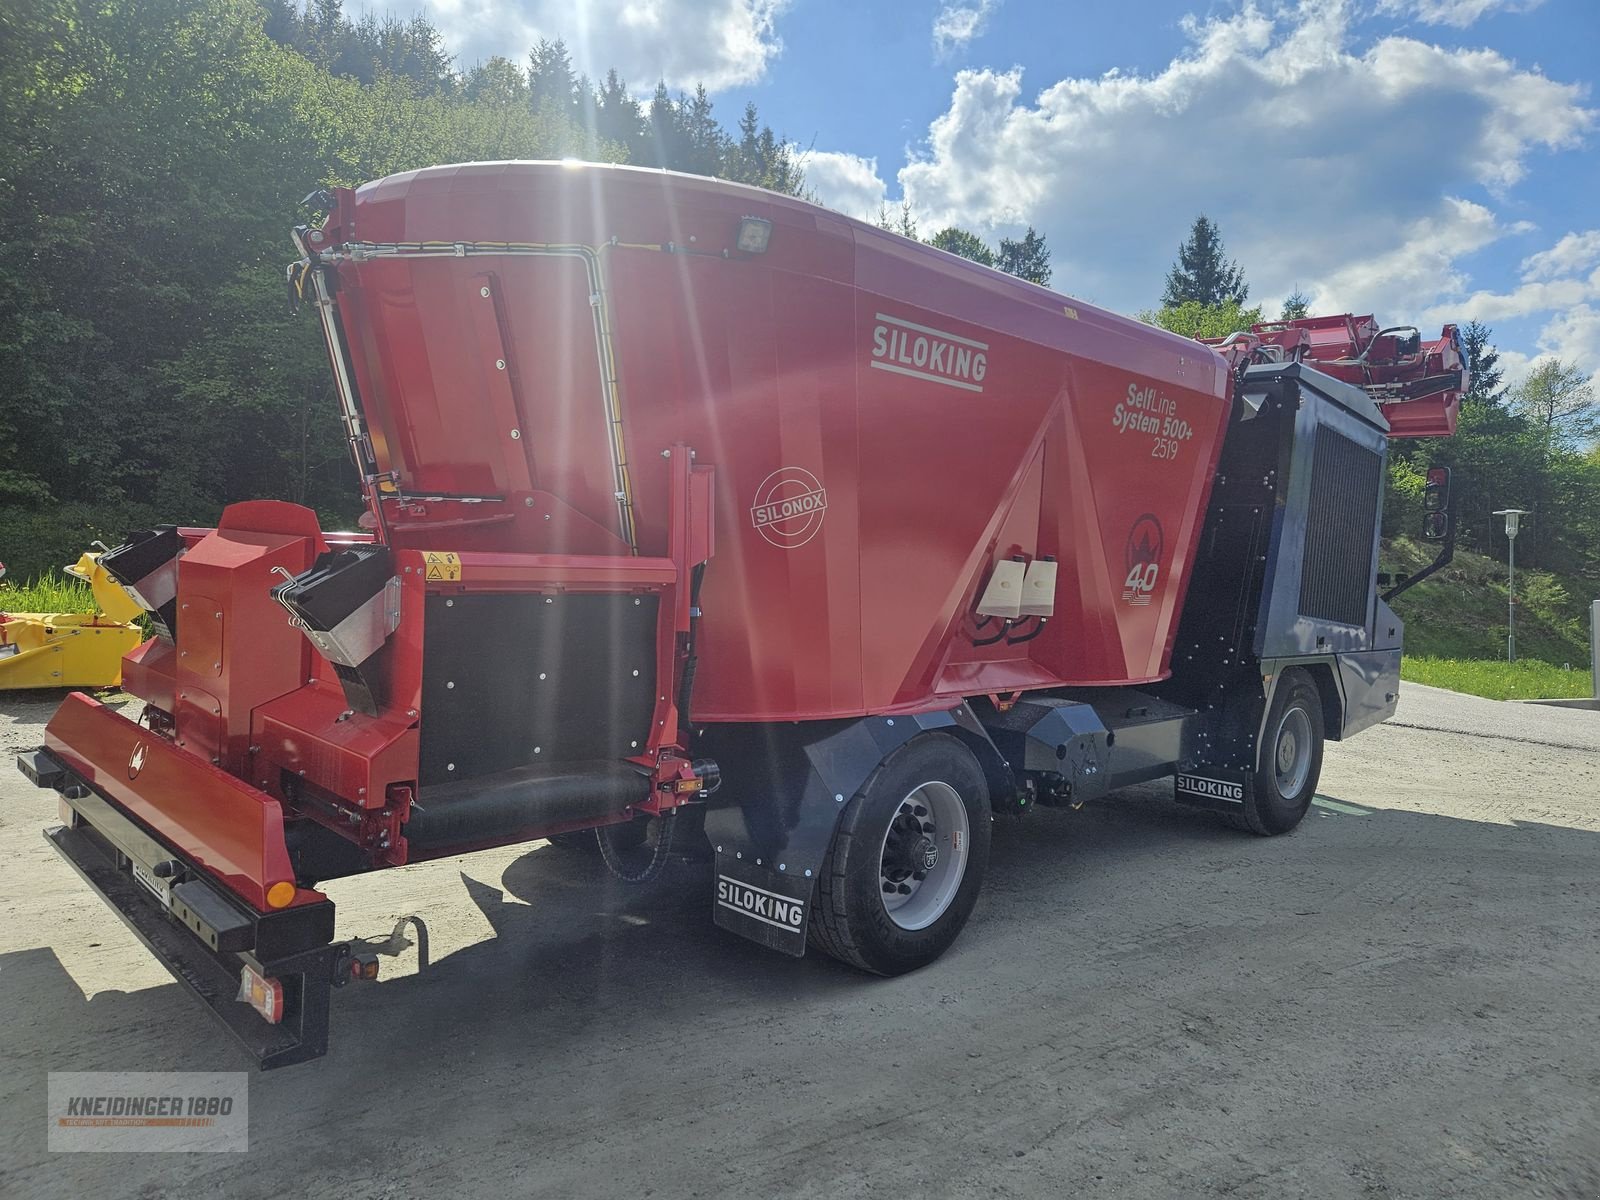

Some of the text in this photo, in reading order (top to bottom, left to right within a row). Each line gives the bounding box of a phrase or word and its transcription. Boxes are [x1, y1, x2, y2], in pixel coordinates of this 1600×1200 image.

[872, 327, 987, 382] SILOKING
[1126, 383, 1177, 416] SelfLine
[1113, 403, 1193, 440] System 500+
[1152, 438, 1178, 460] 2519
[756, 494, 824, 524] SILONOX
[1178, 776, 1243, 799] SILOKING
[718, 881, 803, 926] SILOKING
